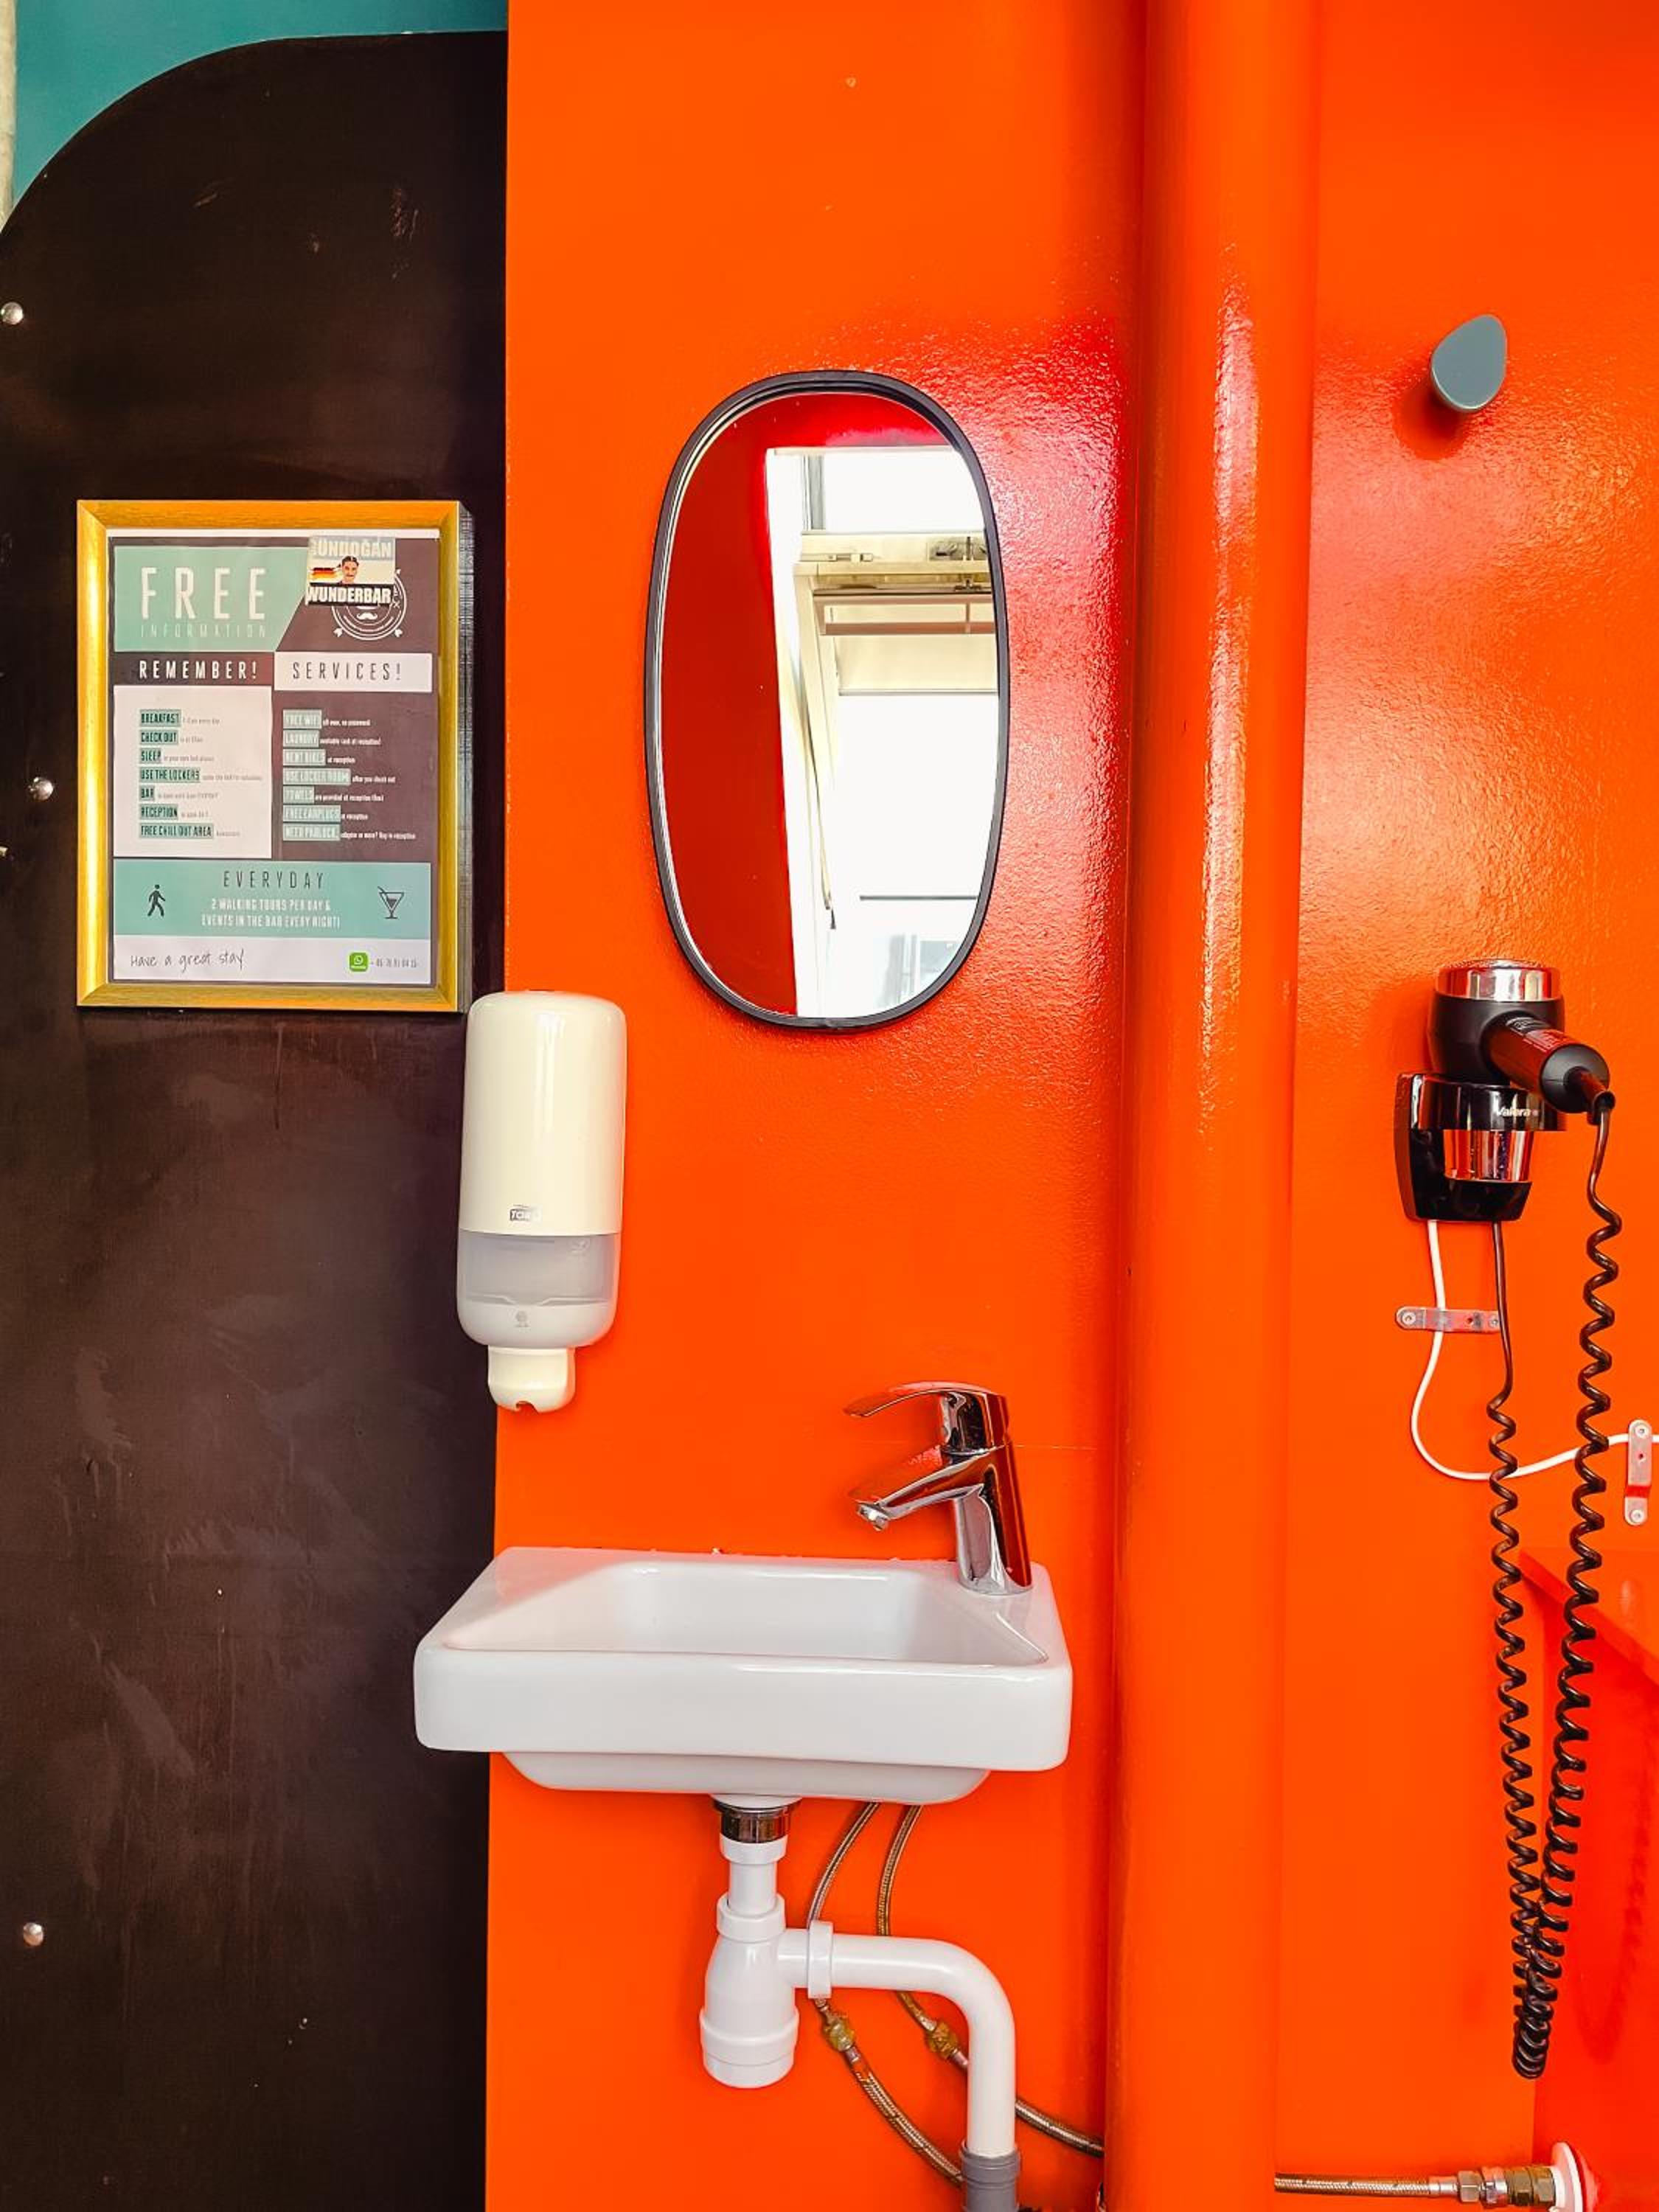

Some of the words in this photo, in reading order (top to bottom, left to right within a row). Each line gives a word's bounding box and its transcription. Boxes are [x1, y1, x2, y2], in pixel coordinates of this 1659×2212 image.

[141, 567, 265, 619] FREE
[308, 586, 392, 604] WUNDERBAR
[141, 623, 265, 638] INFORMATION
[139, 660, 257, 679] REMEMBER!
[293, 661, 402, 681] SERVICES!
[141, 713, 179, 723] BREAKFAST
[141, 732, 163, 742] CHECK
[164, 732, 177, 742] OUT
[141, 750, 161, 761] SLEEP
[141, 769, 153, 779] USE
[155, 769, 167, 779] THE
[169, 769, 200, 779] LOCKERS
[141, 788, 154, 799] BAR
[141, 807, 178, 818] RECEPTION
[141, 825, 156, 835] FREE
[159, 825, 176, 836] CHILL
[178, 825, 192, 836] OUT
[193, 825, 212, 837] AREA
[224, 871, 324, 888] EVERYDAY
[212, 899, 217, 910] 2
[218, 899, 258, 911] WALKING
[260, 899, 287, 911] TOURS
[290, 900, 305, 911] PER
[307, 900, 323, 911] DAY
[201, 914, 233, 926] EVENTS
[235, 915, 244, 926] IN
[247, 915, 263, 927] THE
[265, 915, 282, 927] BAR
[285, 916, 310, 928] EVERY
[312, 916, 341, 928] NIGHT!
[131, 955, 157, 967] Have
[164, 955, 172, 966] a
[179, 950, 211, 973] great
[219, 947, 244, 971] stay
[1496, 1107, 1531, 1117] Valera
